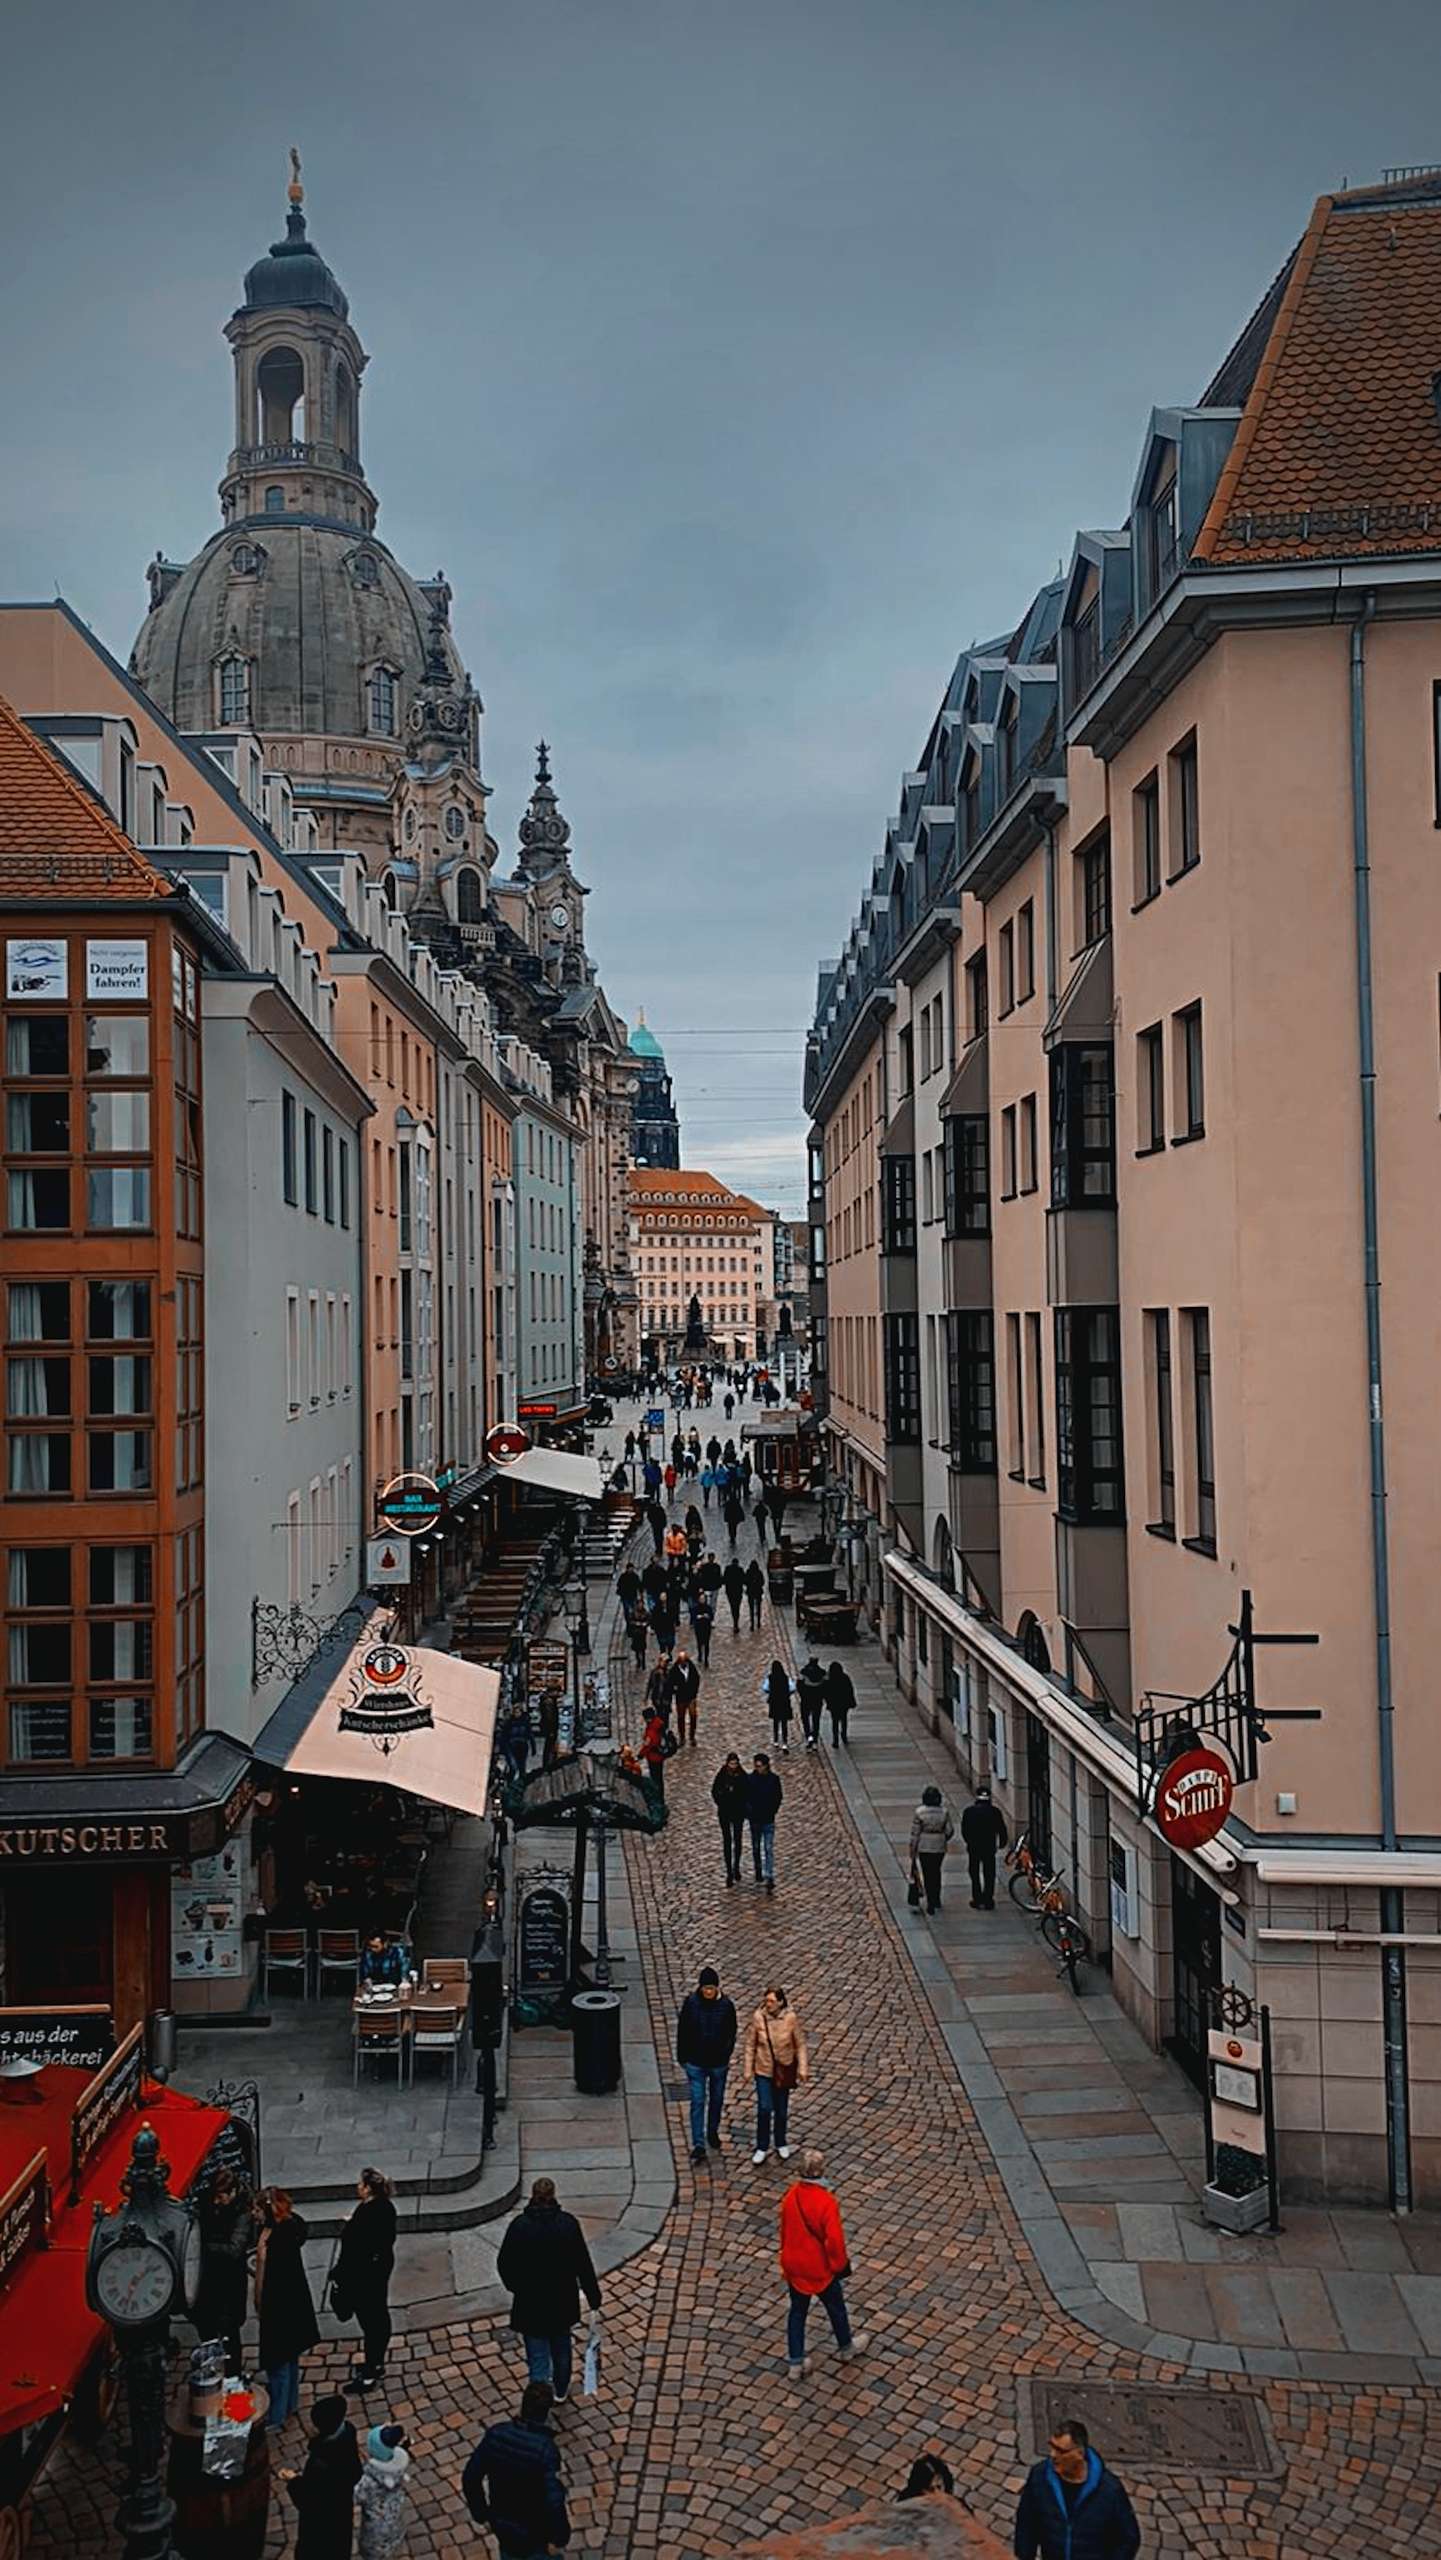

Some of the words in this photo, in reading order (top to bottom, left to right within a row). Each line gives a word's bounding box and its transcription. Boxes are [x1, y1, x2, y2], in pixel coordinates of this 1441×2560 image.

[90, 963, 146, 976] Dampfer
[95, 977, 141, 988] fahren!
[404, 1494, 422, 1503] BAR
[384, 1503, 441, 1513] RESTAURANT
[0, 1825, 168, 1855] KUTSCHER
[14, 2029, 46, 2044] aus
[48, 2025, 79, 2043] der
